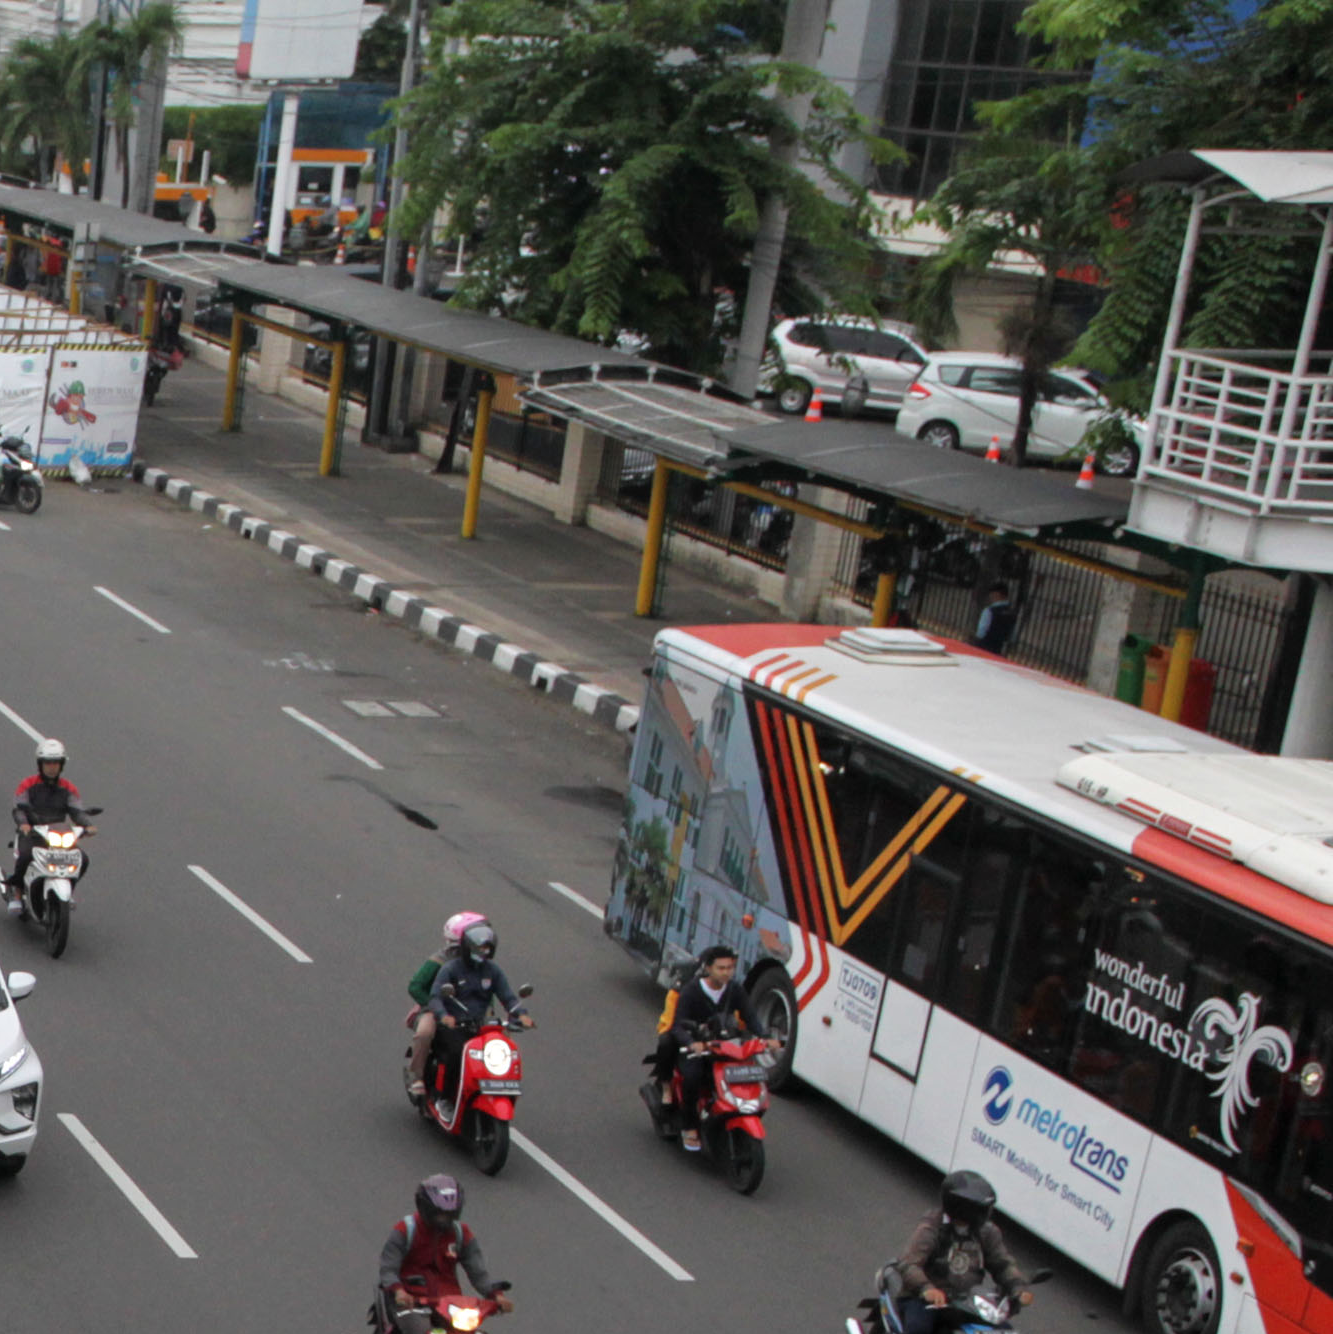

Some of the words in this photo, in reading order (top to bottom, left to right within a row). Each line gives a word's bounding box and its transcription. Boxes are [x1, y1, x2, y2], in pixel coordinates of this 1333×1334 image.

[1094, 948, 1185, 1011] wonderful
[1085, 982, 1210, 1072] indonesia
[971, 1127, 1006, 1159] SMART
[1006, 1149, 1044, 1187] Mobility
[1044, 1174, 1060, 1193] for
[1060, 1184, 1093, 1216] Smart
[1093, 1206, 1116, 1232] City
[1016, 1098, 1129, 1193] metrotrans
